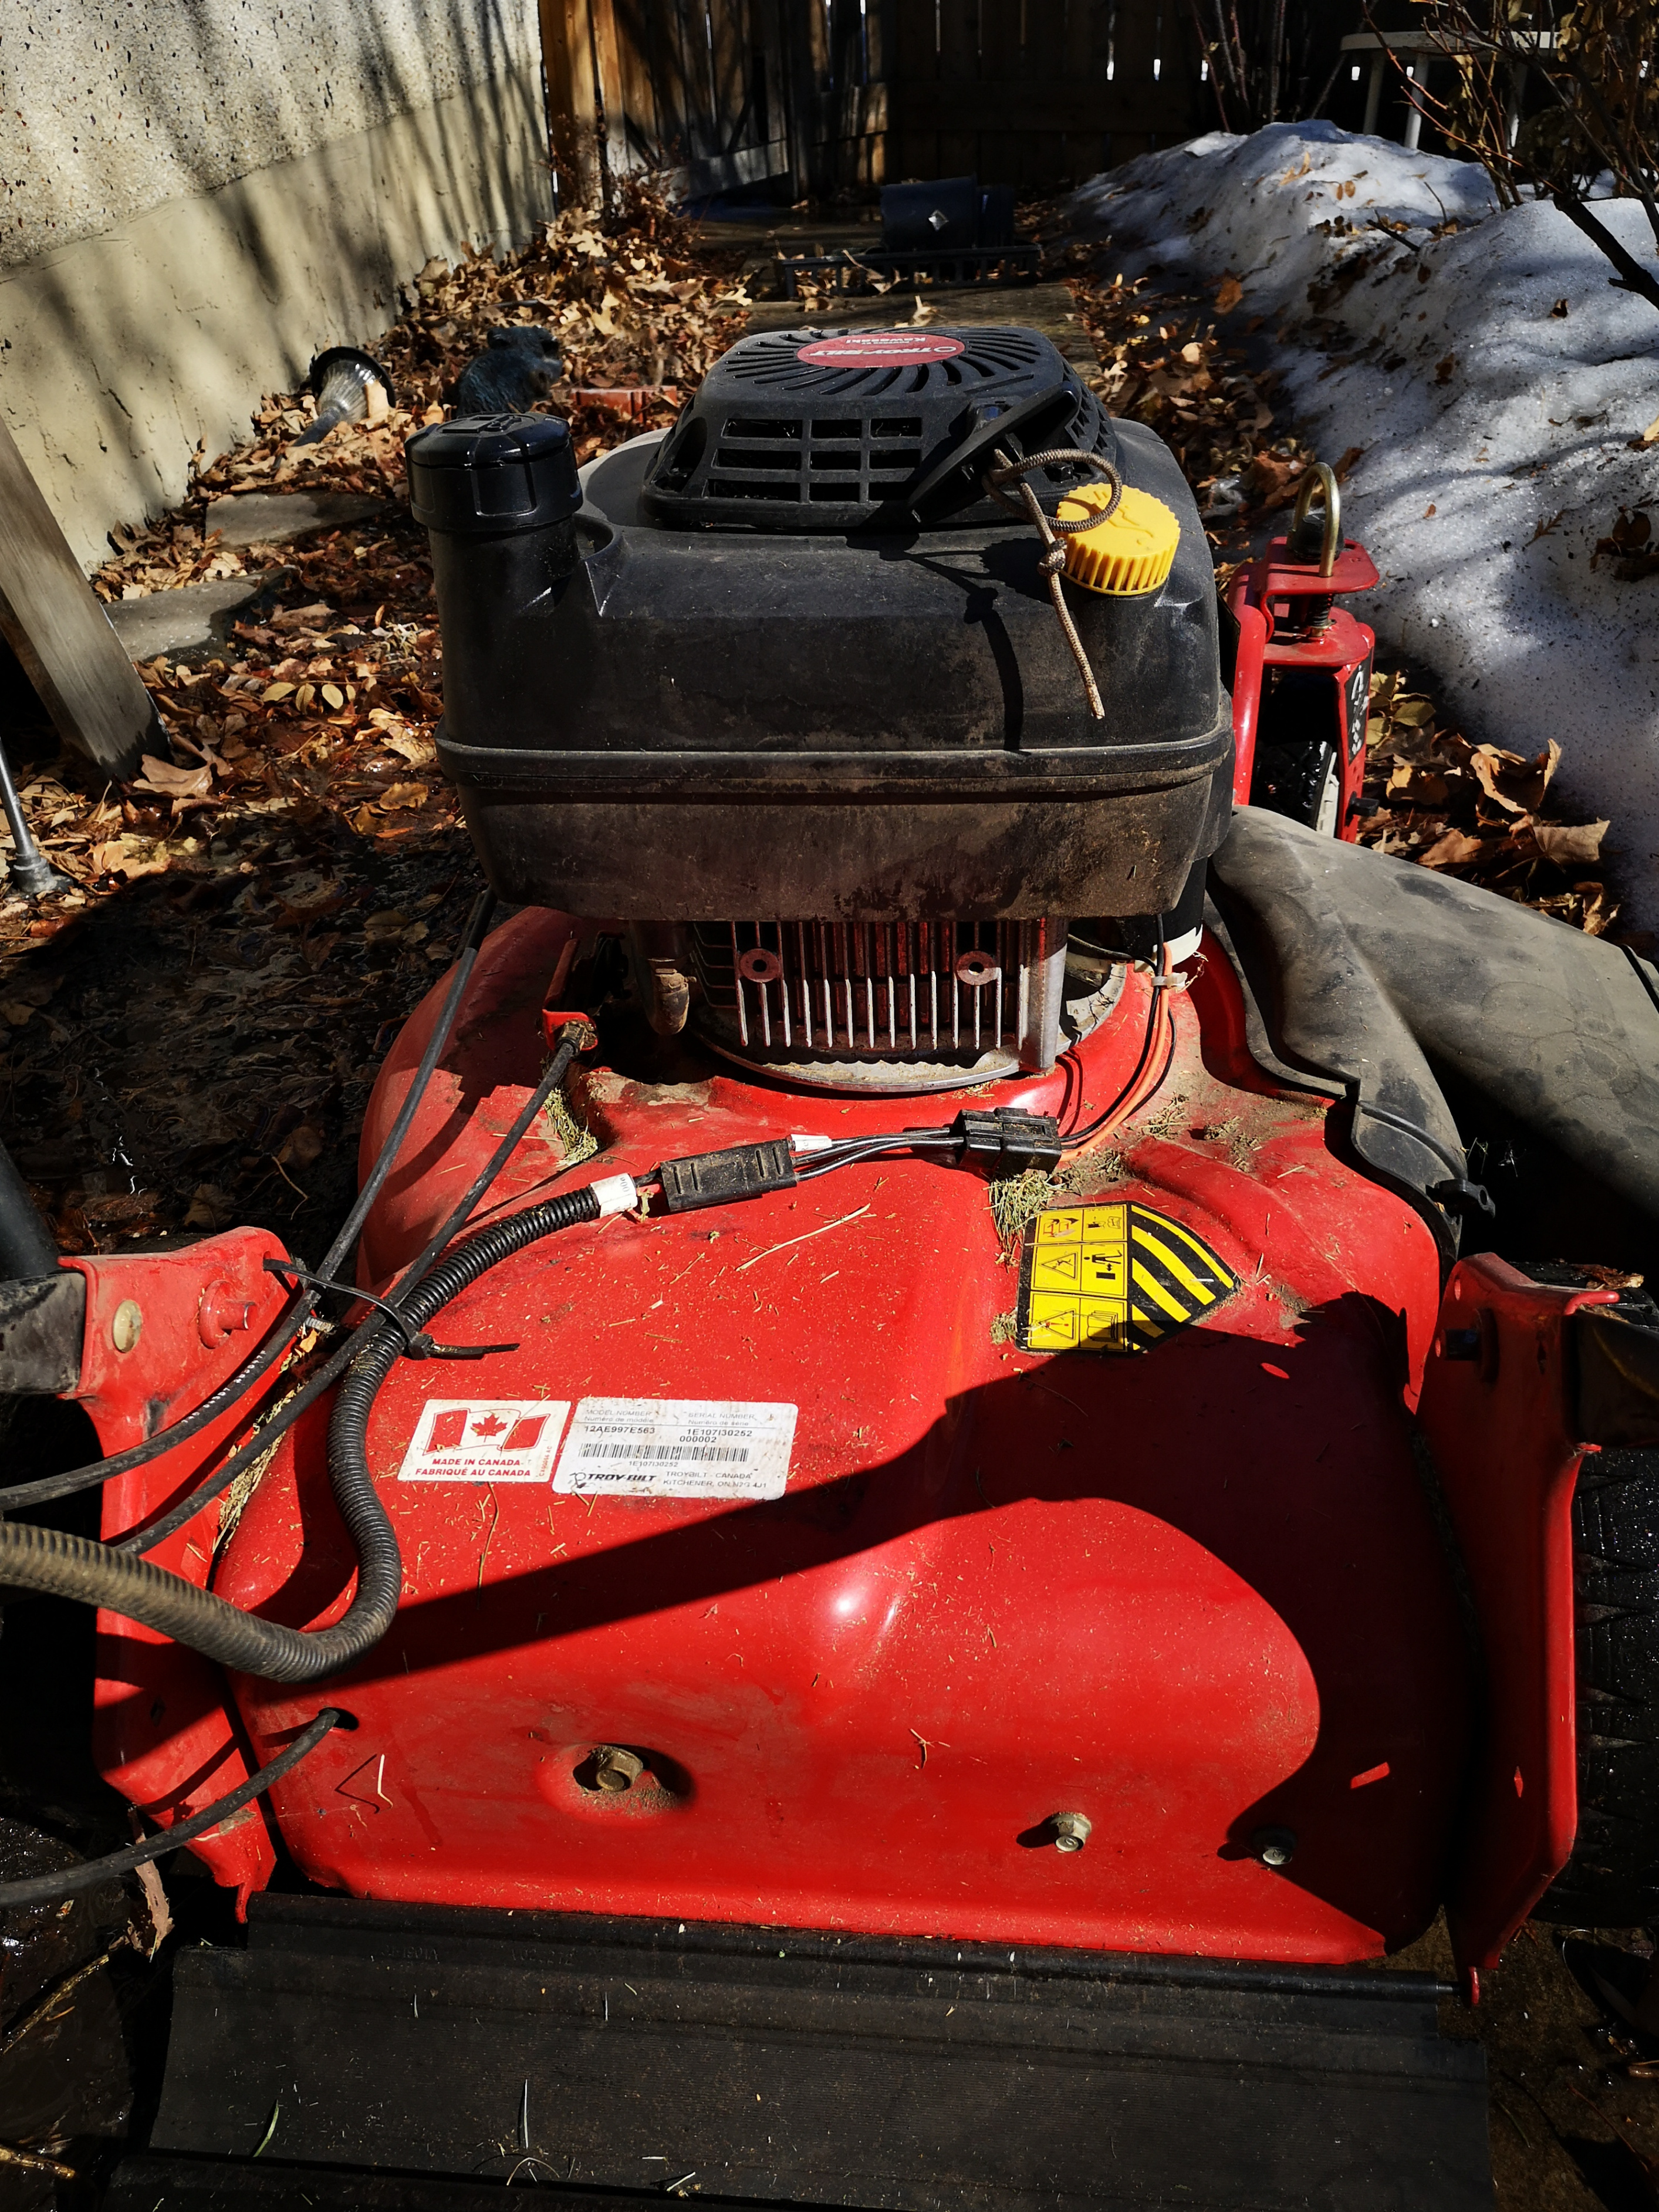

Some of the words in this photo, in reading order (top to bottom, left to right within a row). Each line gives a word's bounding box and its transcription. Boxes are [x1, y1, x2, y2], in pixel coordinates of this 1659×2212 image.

[810, 347, 932, 356] TROY-BILT
[584, 1426, 656, 1434] 12AE997E563
[415, 1468, 468, 1476] FABRIQUÉ
